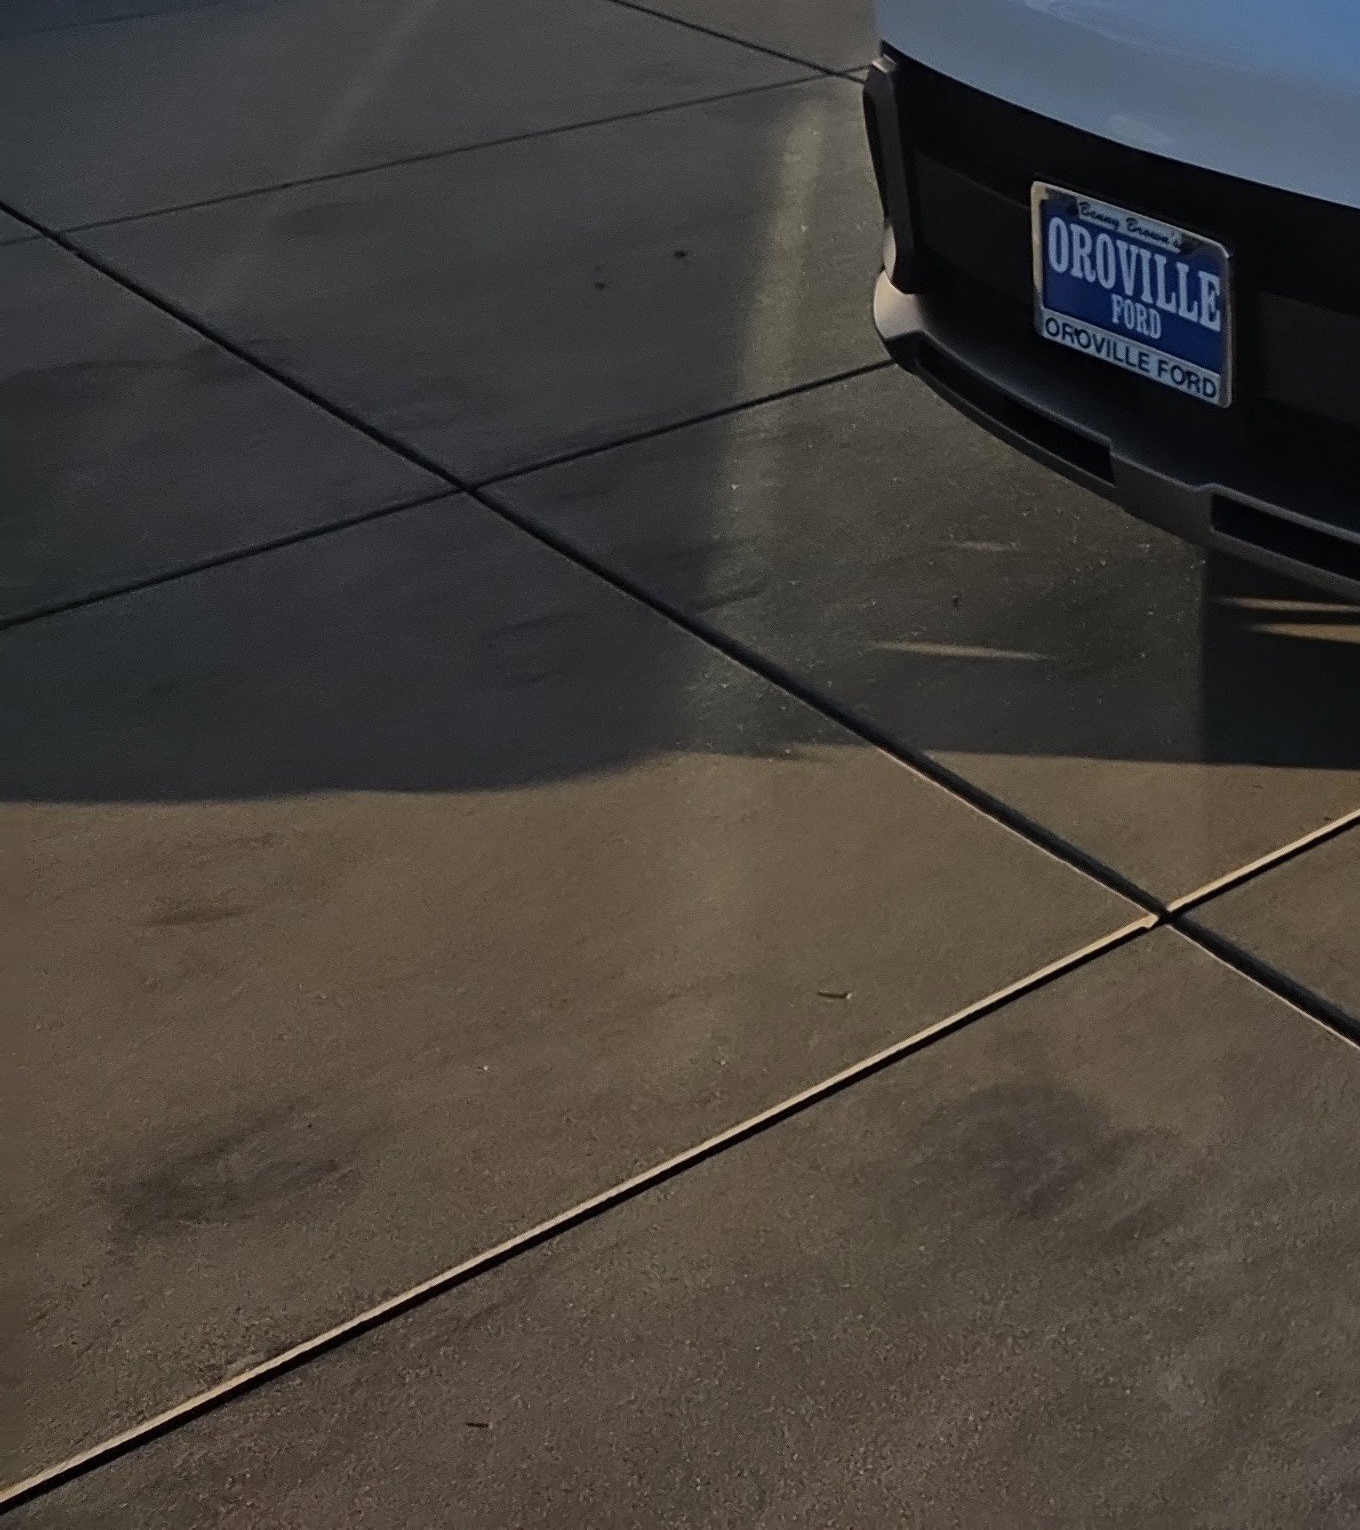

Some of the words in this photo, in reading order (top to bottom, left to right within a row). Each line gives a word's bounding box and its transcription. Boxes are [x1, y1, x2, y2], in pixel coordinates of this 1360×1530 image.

[1049, 217, 1221, 332] OROVILLE
[1111, 293, 1162, 340] FORD
[1045, 317, 1150, 372] OROVILLE
[1157, 359, 1217, 399] FORD
